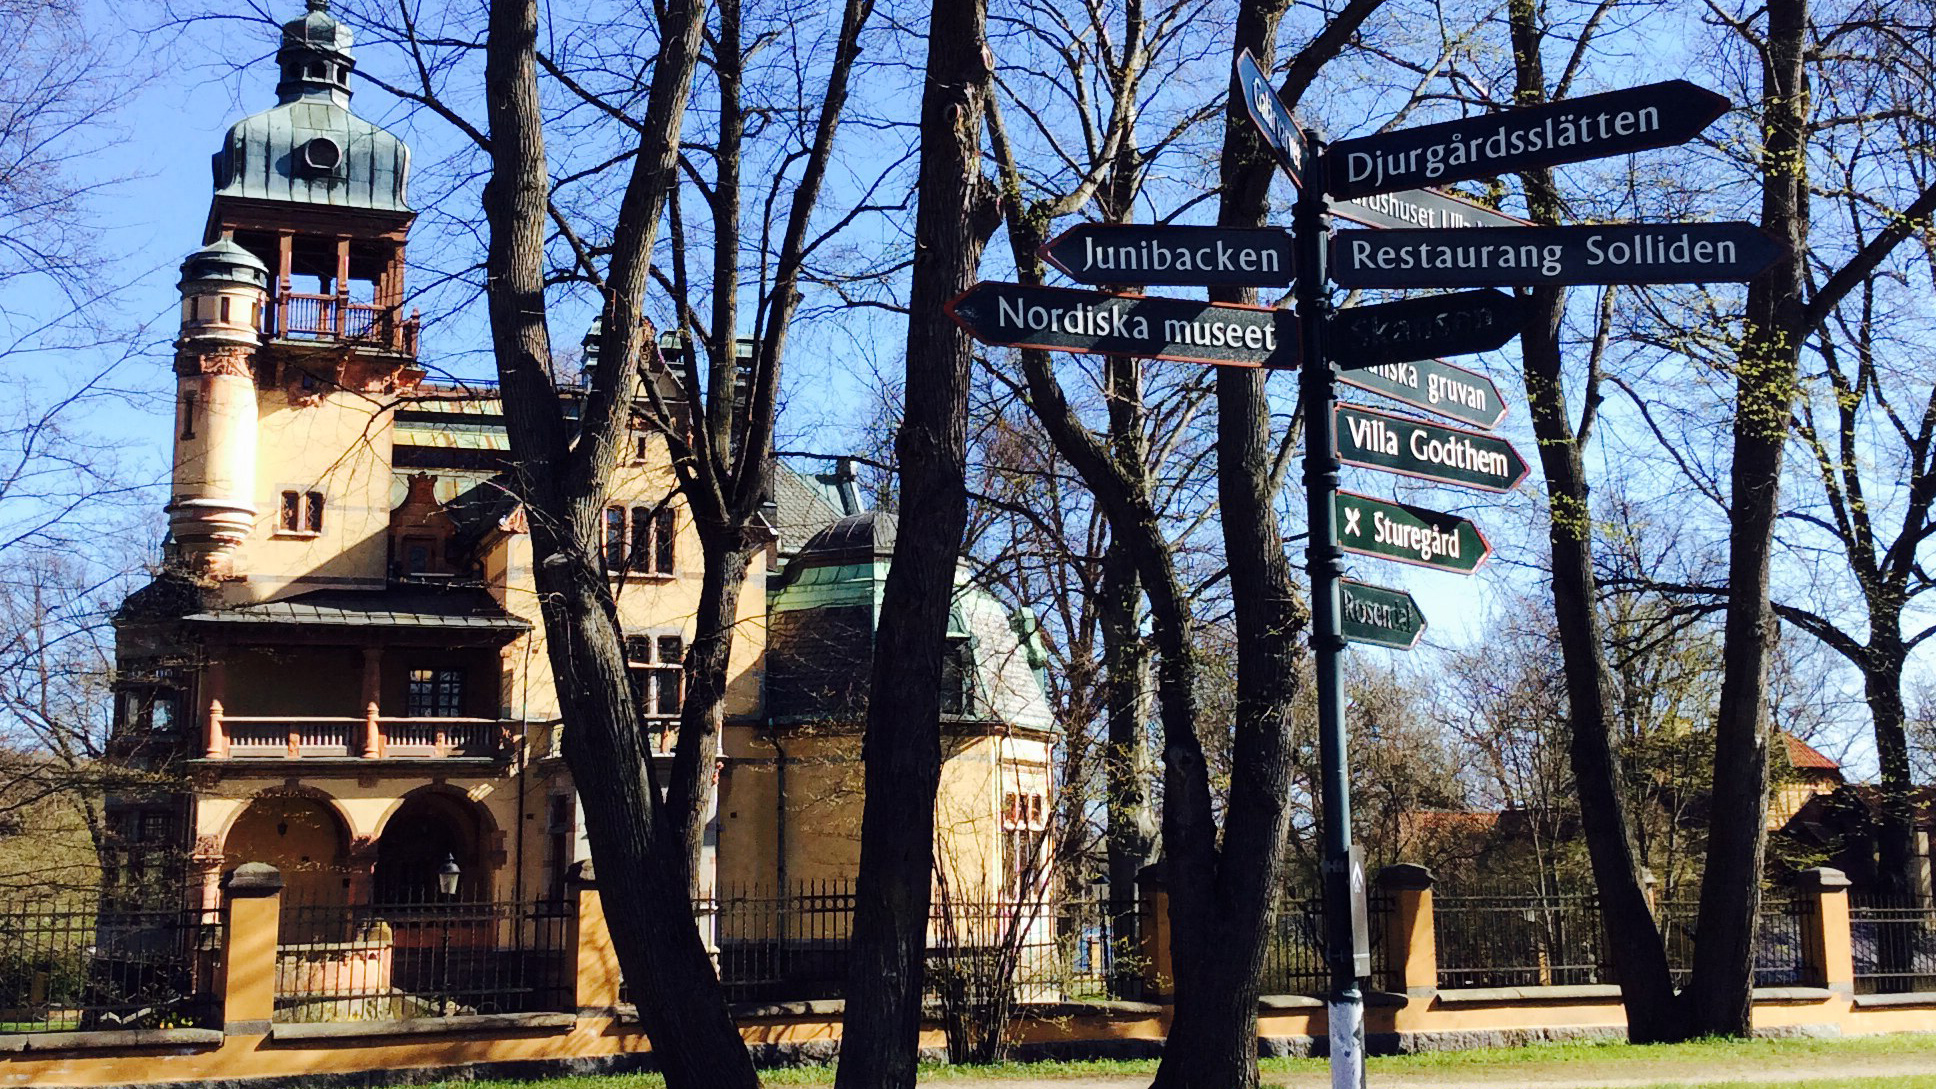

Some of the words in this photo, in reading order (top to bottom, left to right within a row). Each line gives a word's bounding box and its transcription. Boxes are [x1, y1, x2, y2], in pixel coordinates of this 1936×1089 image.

[1347, 104, 1661, 186] Djurgårdsslätten
[1083, 236, 1280, 272] Junibacken
[1353, 238, 1563, 276] Restaurang
[1586, 234, 1738, 266] Solliden
[998, 295, 1149, 340] Nordiska
[1164, 317, 1278, 351] museet
[1427, 372, 1487, 412] gruvan
[1345, 415, 1399, 456] Villa
[1409, 428, 1509, 478] Godthem
[1373, 510, 1461, 561] Sturegård
